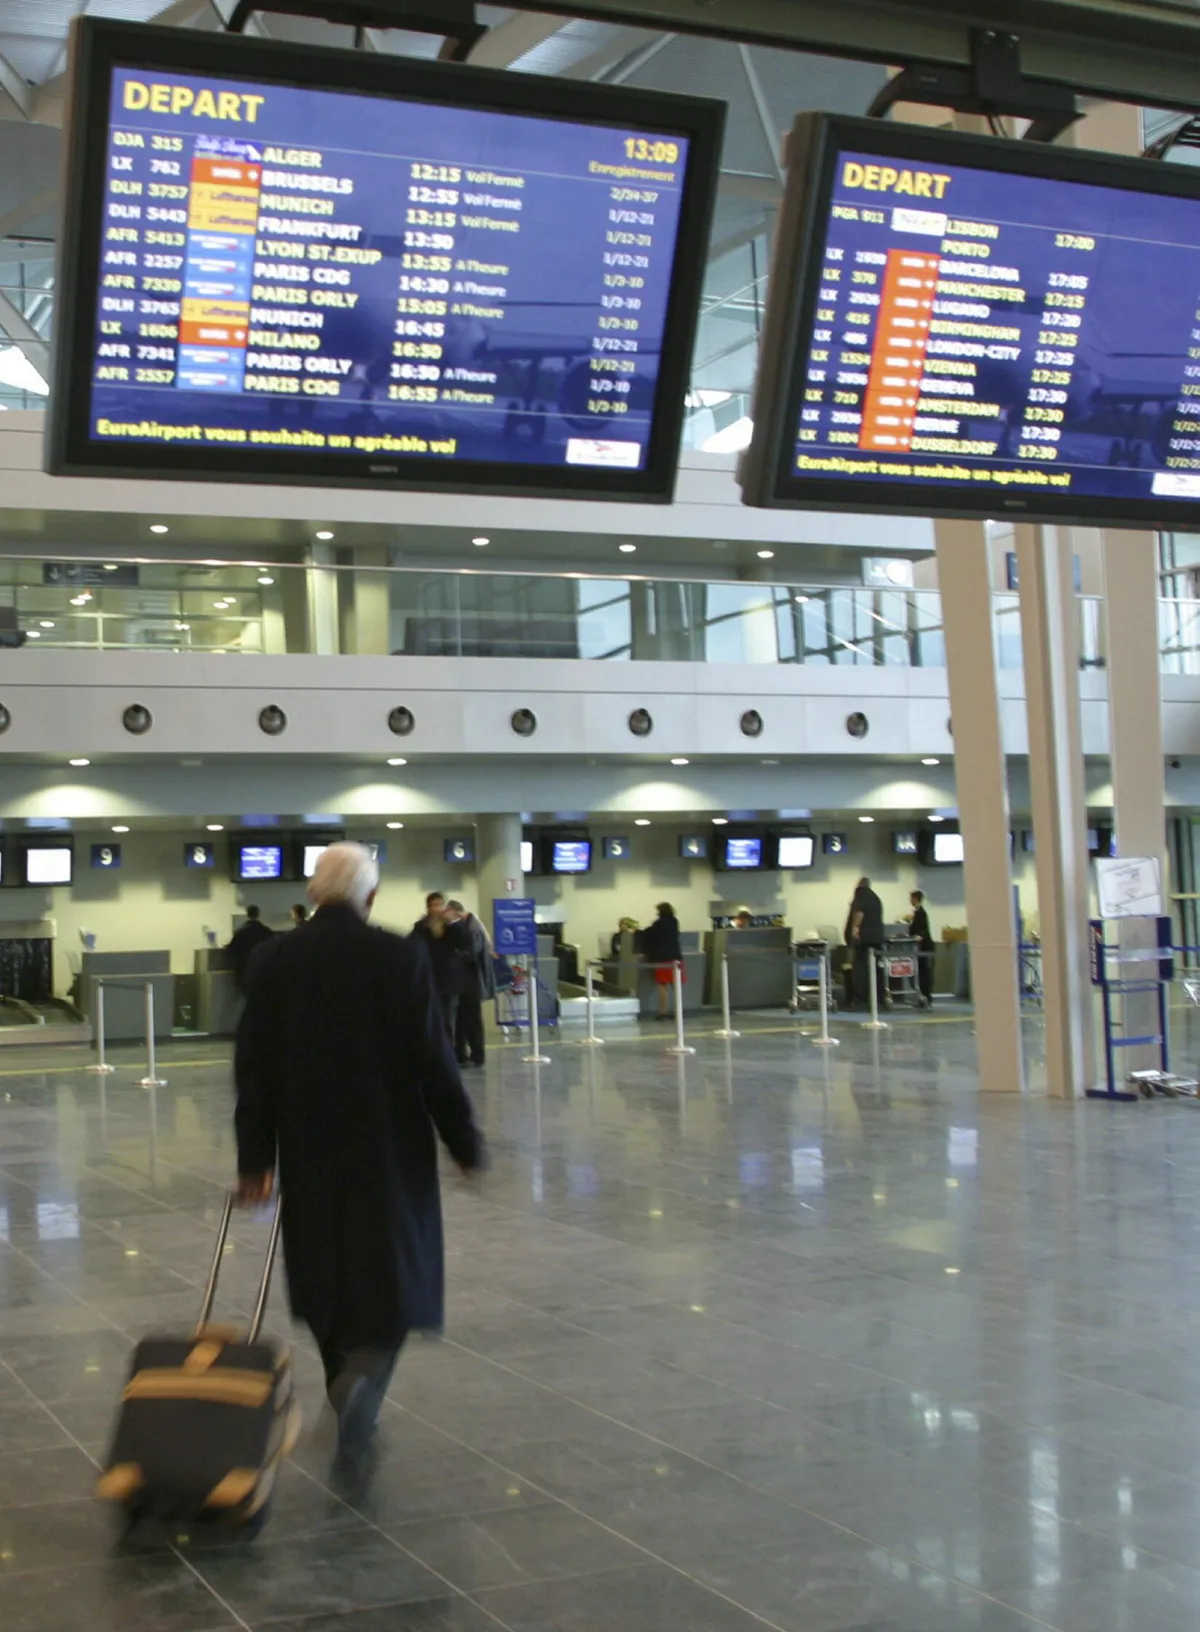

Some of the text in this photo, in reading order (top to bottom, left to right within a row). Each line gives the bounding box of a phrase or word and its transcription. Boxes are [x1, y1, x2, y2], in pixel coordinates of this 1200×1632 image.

[123, 81, 265, 123] DEPART
[151, 135, 184, 152] 315
[263, 147, 323, 169] ALGER
[410, 163, 462, 183] 12:15
[624, 137, 678, 164] 13:09
[111, 156, 133, 171] LX
[261, 170, 354, 195] BRUSSELS
[842, 161, 952, 199] DEPART
[110, 180, 142, 196] DLH
[260, 193, 334, 216] MUNICH
[406, 208, 456, 228] 13:15
[108, 203, 141, 220] DLH
[257, 216, 363, 242] FRANKFURT
[947, 220, 999, 239] LISBON
[106, 227, 138, 243] AFR
[255, 239, 305, 259] LYON
[307, 244, 383, 266] ST.EXUP
[941, 239, 991, 258] PORTO
[104, 250, 137, 266] AFR
[254, 263, 310, 282] PARIS
[312, 267, 351, 286] CDG
[103, 274, 136, 289] AFR
[252, 285, 308, 305] PARIS
[310, 290, 359, 309] ORLY
[397, 297, 447, 316] 15:05
[936, 280, 1026, 303] MANCHESTER
[102, 297, 135, 312] DLH
[250, 308, 324, 329] MUNICH
[100, 320, 122, 335] LX
[248, 330, 321, 350] MILANO
[929, 319, 1021, 342] BIRMINGHAM
[98, 343, 131, 359] AFR
[246, 352, 302, 371] PARIS
[304, 356, 353, 375] ORLY
[926, 339, 1021, 360] LONDON-CITY
[96, 366, 129, 381] AFR
[244, 375, 300, 393] PARIS
[302, 379, 341, 396] CDG
[924, 359, 977, 377] VIENNA
[916, 398, 1001, 418] AMSTERDAM
[97, 418, 202, 442] EuroAirport
[205, 425, 247, 443] vous
[250, 429, 325, 447] souhaite
[329, 433, 352, 448] un
[430, 438, 456, 454] vol
[910, 436, 998, 456] DUSSELDORF
[797, 455, 878, 474] EuroAirport
[879, 462, 912, 476] vous
[972, 469, 991, 481] un
[1049, 472, 1071, 487] vol
[101, 849, 113, 866] 9
[193, 846, 206, 864] 8
[453, 841, 465, 859] 6
[831, 835, 842, 852] 3
